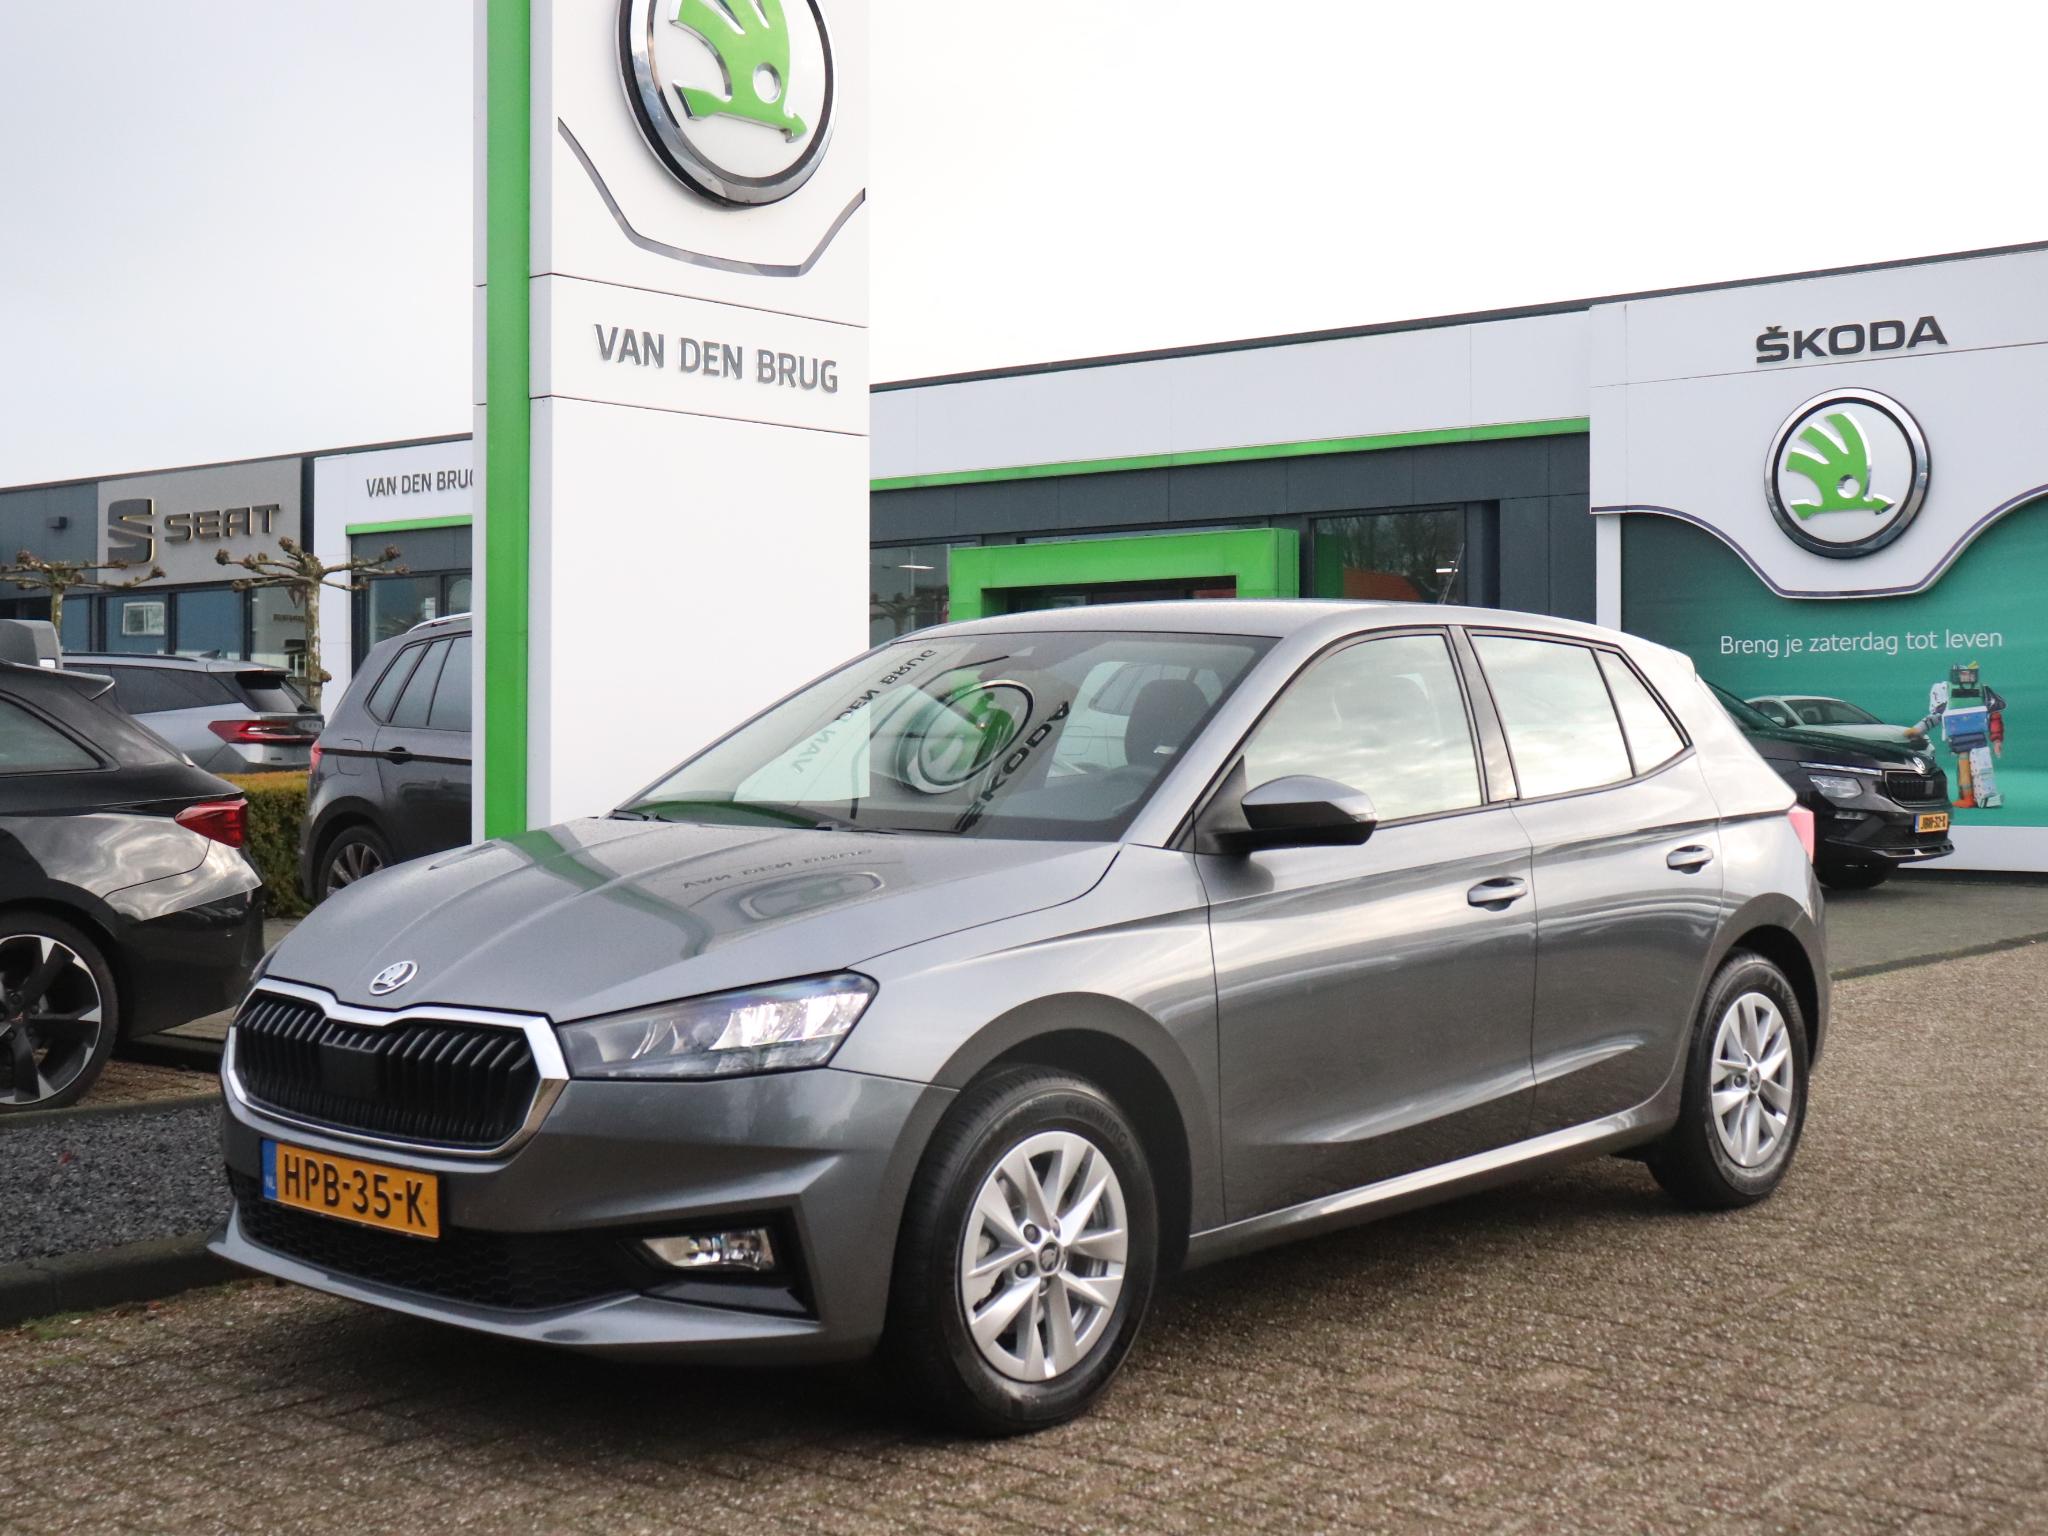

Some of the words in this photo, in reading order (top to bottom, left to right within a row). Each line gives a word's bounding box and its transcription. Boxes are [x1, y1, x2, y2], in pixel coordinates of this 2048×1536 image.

[594, 323, 665, 369] VAN
[680, 337, 743, 380] DEN
[757, 349, 838, 394] BRUG
[1756, 315, 1948, 363] ŠKODA
[366, 476, 397, 498] VAN
[401, 472, 432, 495] DEN
[164, 503, 281, 544] SEAT
[1720, 635, 1779, 658] Breng
[1784, 634, 1803, 658] je
[1809, 631, 1899, 656] zaterdag
[1905, 630, 1939, 650] tot
[1945, 628, 2003, 649] leven
[284, 1153, 427, 1228] HPB-35-K
